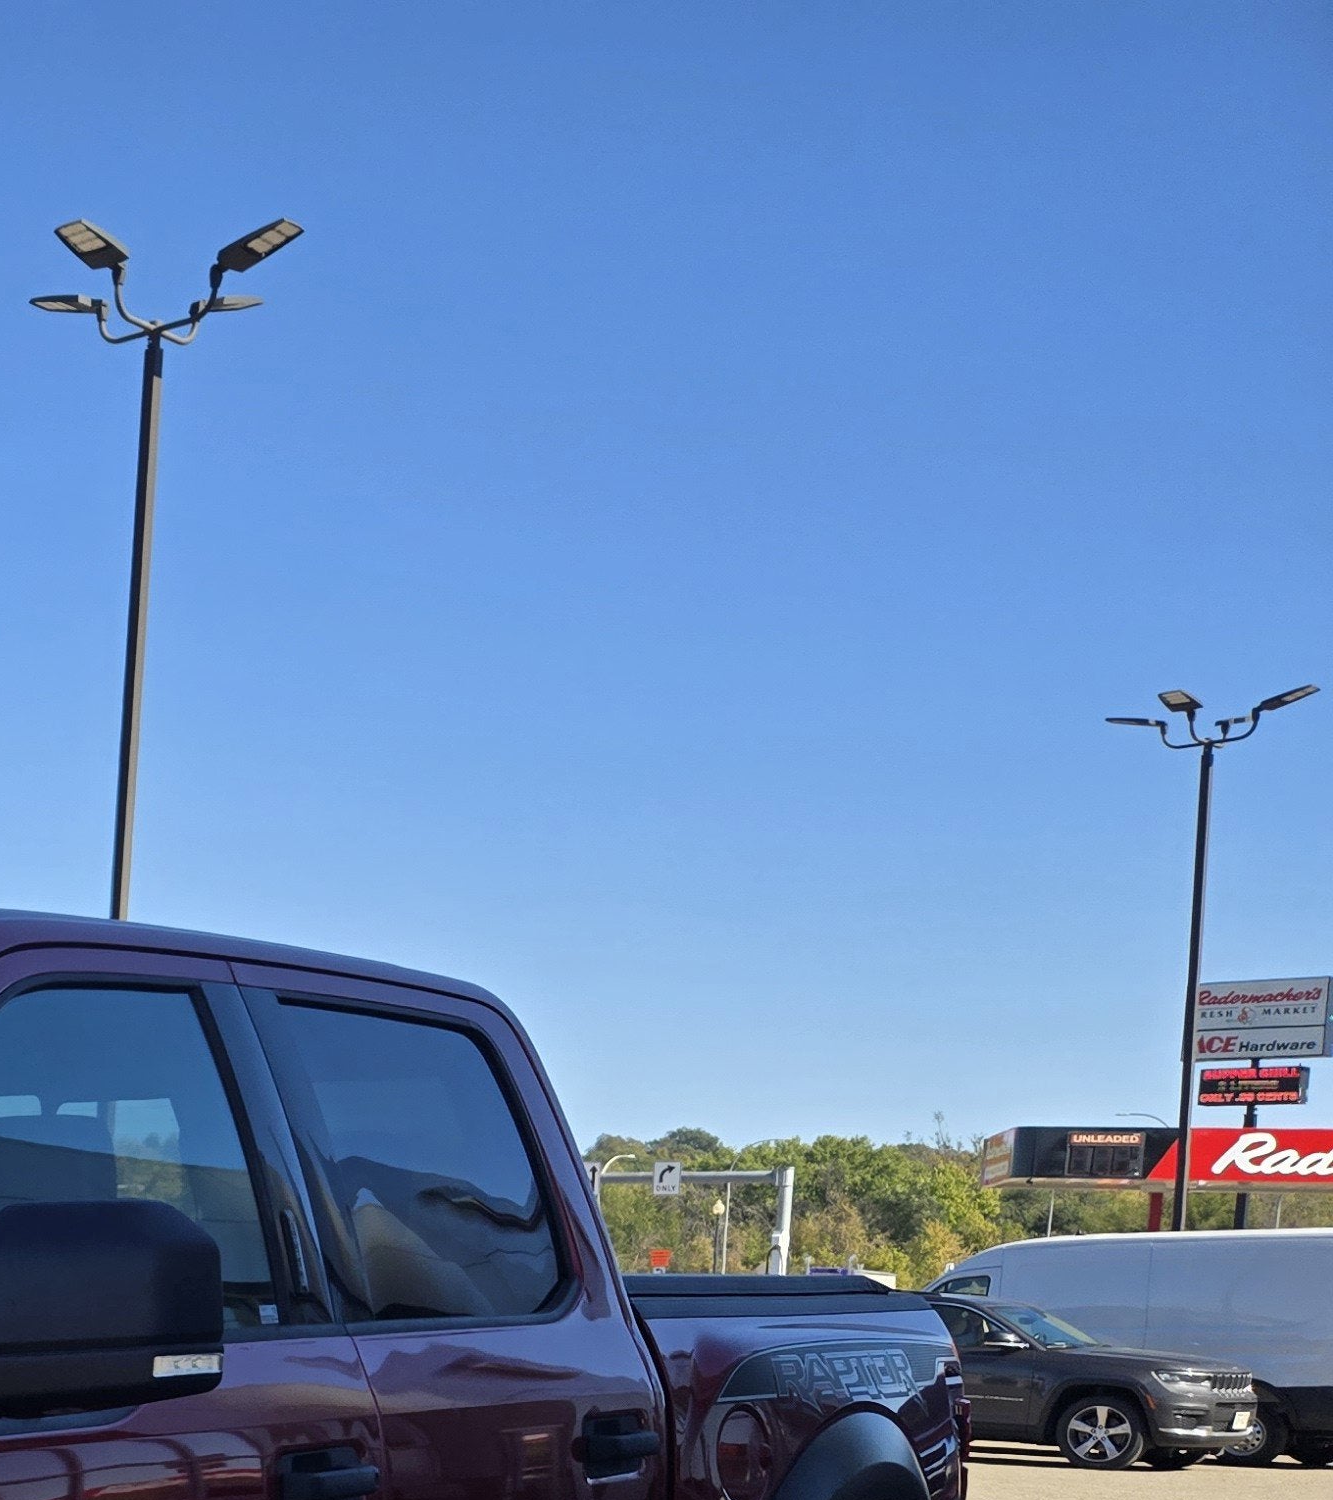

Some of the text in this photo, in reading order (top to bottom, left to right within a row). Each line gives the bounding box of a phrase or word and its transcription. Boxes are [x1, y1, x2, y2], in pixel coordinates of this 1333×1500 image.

[1200, 1006, 1317, 1019] RESH MARKET
[1238, 1039, 1316, 1053] Hardware
[1073, 1134, 1139, 1144] UNLEADED
[771, 1348, 930, 1418] RAPTOR
